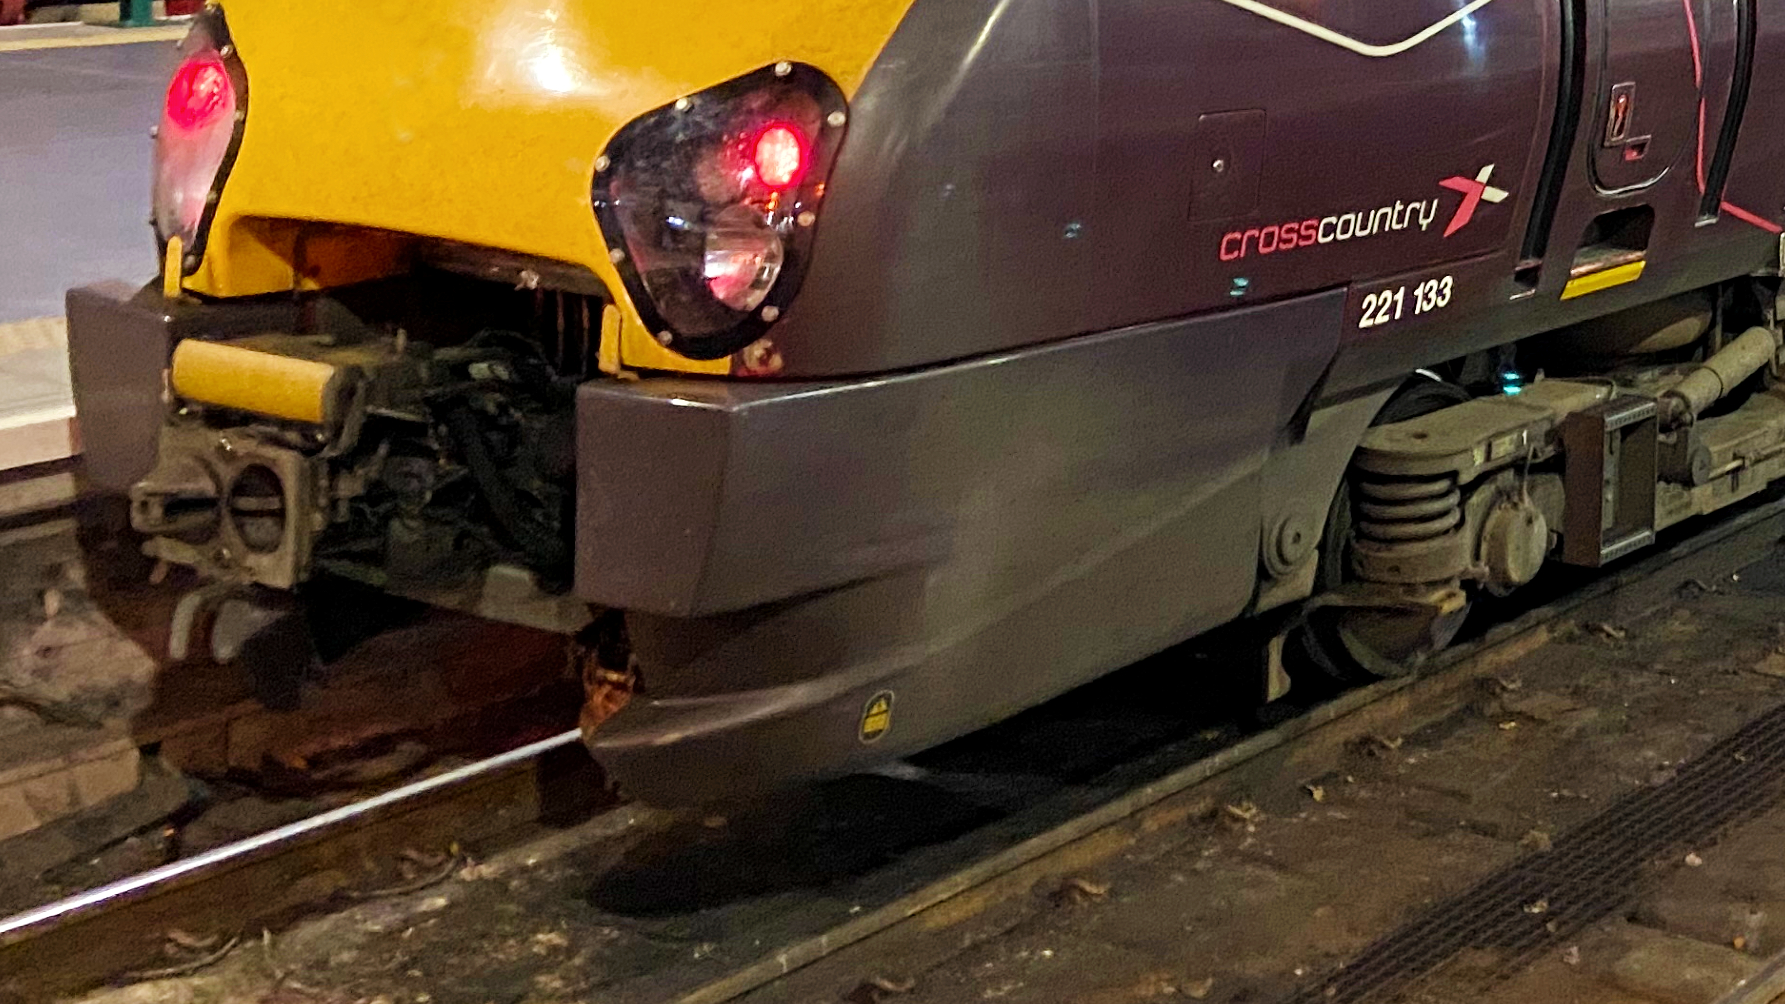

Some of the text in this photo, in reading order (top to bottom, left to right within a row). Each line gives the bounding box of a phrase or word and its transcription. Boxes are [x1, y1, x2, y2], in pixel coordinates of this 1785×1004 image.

[1218, 198, 1439, 261] crosscountry
[1358, 275, 1454, 329] 221 133
